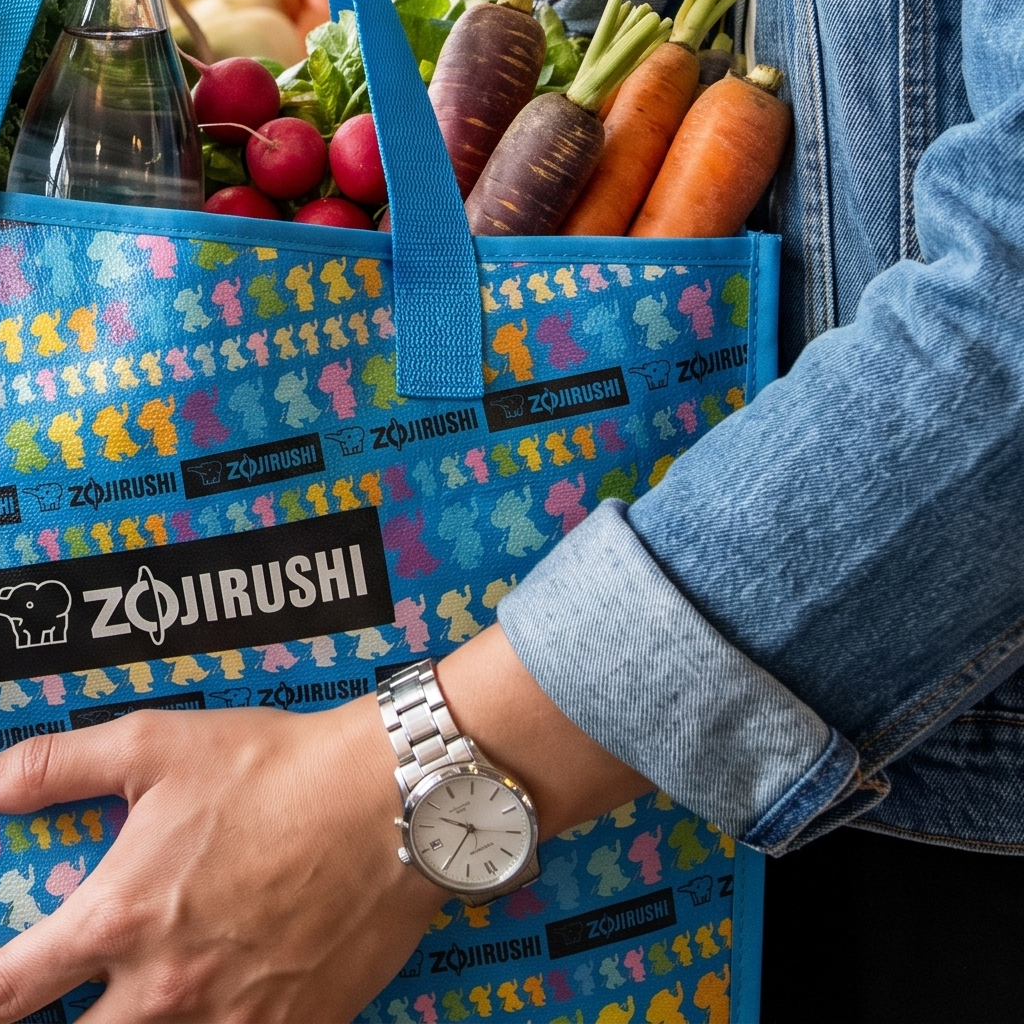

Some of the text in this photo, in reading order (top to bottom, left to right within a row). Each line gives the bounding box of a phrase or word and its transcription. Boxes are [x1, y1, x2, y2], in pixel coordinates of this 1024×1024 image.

[68, 471, 178, 511] ZOJIRUSHI
[227, 445, 318, 482] ZOJIRUSHI
[370, 407, 479, 451] ZOJIRUSHI
[527, 378, 622, 415] ZOJIRUSHI
[82, 544, 368, 645] ZOJIRUSHI
[257, 678, 369, 711] ZOJIRUSHI
[429, 935, 542, 976] ZOJIRUSHI
[586, 899, 670, 939] ZOJIRUSHI
